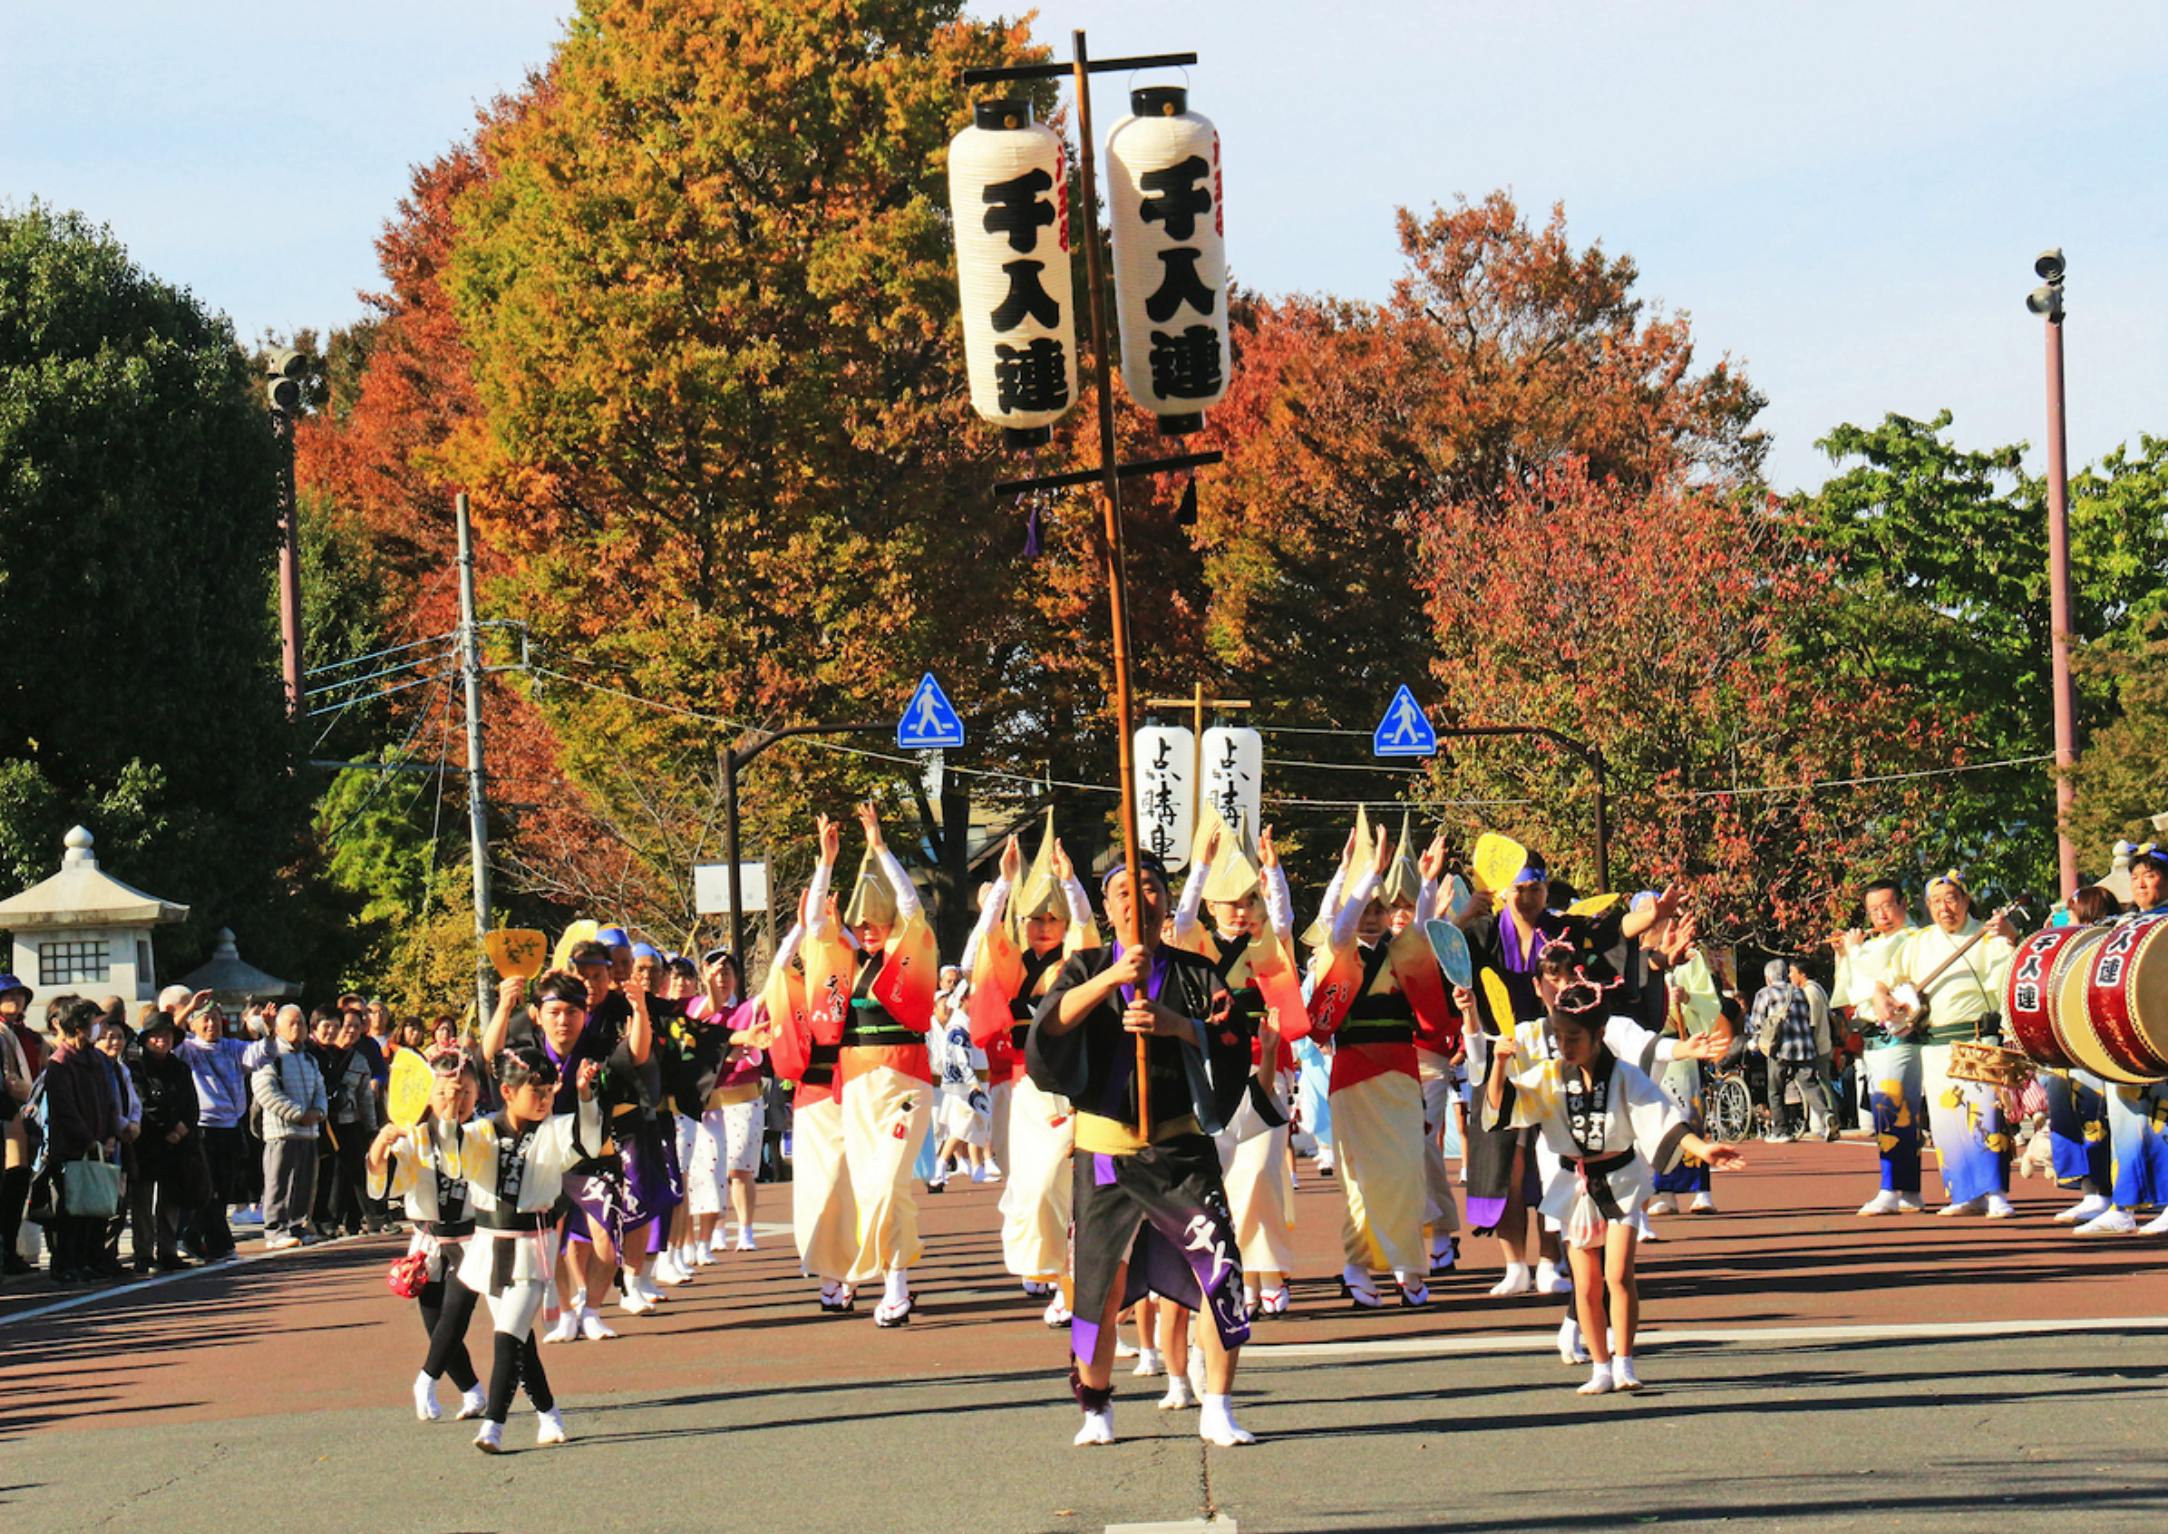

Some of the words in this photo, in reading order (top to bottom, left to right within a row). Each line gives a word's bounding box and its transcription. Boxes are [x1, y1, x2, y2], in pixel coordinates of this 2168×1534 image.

[982, 168, 1069, 414] 千人連
[1140, 155, 1222, 400] 千人連
[2015, 934, 2058, 1011] 千人連
